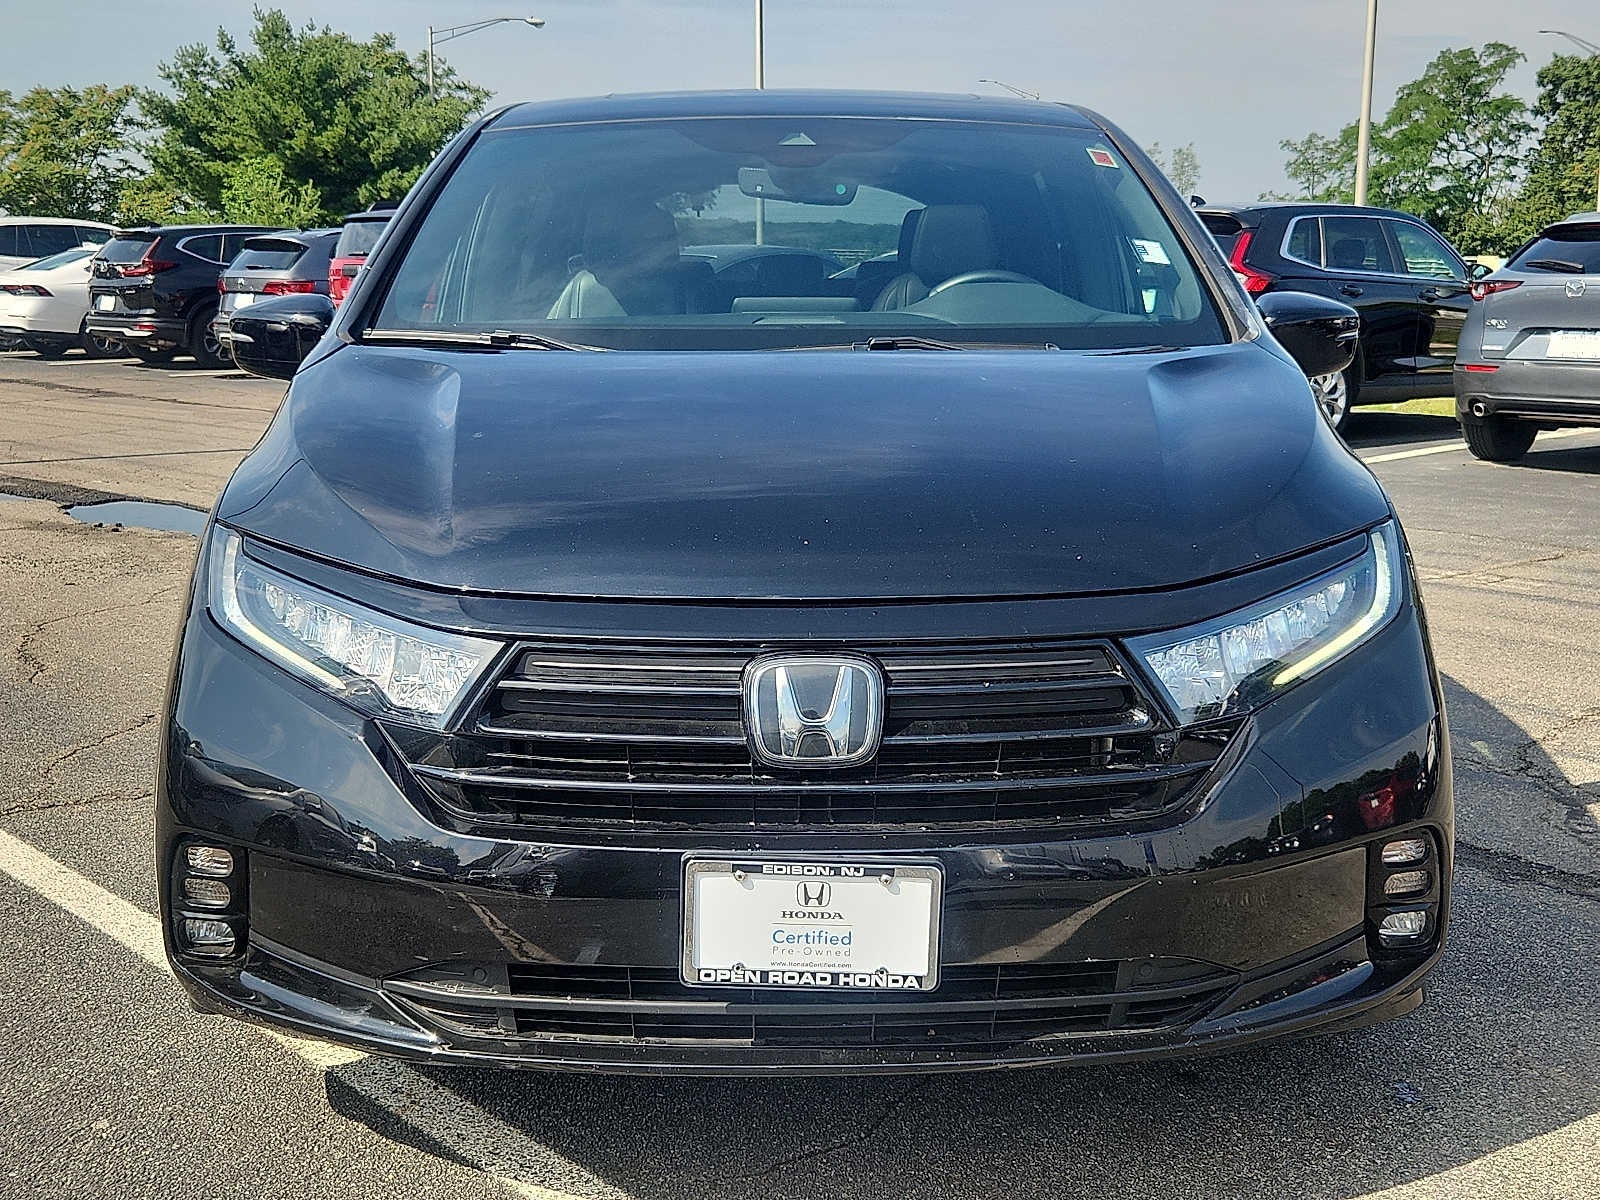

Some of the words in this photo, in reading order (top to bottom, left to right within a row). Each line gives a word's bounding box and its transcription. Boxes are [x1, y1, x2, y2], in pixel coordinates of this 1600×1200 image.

[762, 864, 835, 876] EDISON,
[841, 865, 864, 877] NJ
[781, 911, 844, 919] HONDA
[772, 929, 852, 945] Certified
[772, 946, 851, 957] Pre-Owned
[699, 969, 760, 984] OPEN
[768, 971, 832, 985] ROAD
[838, 972, 920, 989] HONDA
